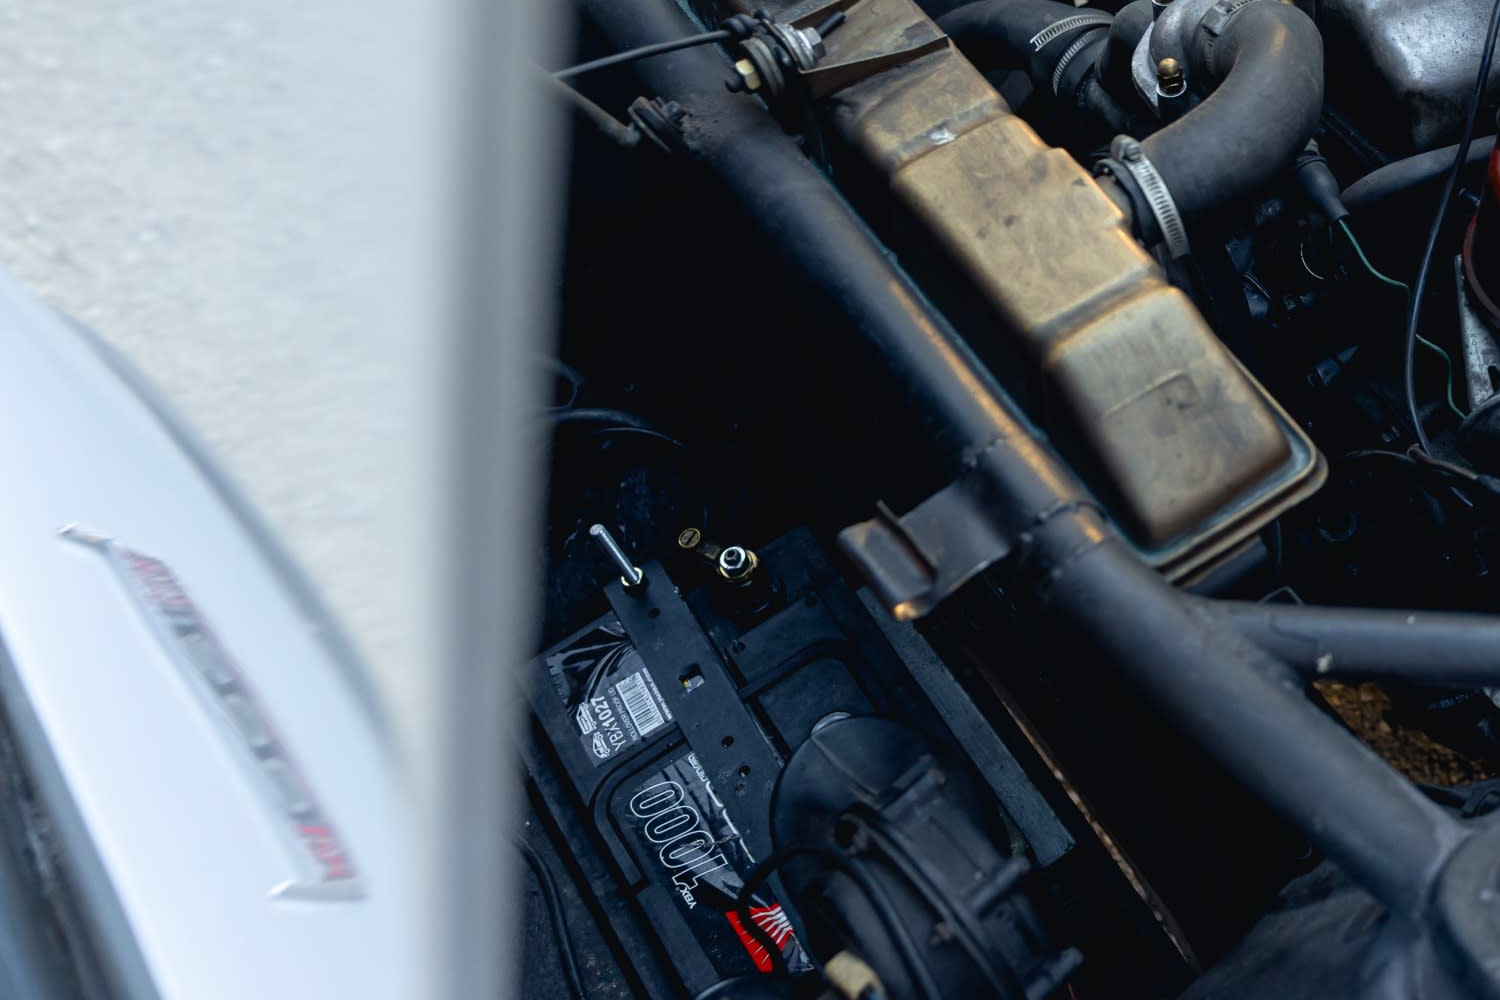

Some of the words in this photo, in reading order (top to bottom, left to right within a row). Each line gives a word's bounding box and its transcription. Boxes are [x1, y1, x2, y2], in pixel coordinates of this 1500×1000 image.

[590, 694, 627, 751] YBX1027
[612, 695, 625, 714] PROOF
[620, 713, 639, 741] ROLLOVER
[631, 781, 727, 889] 1000
